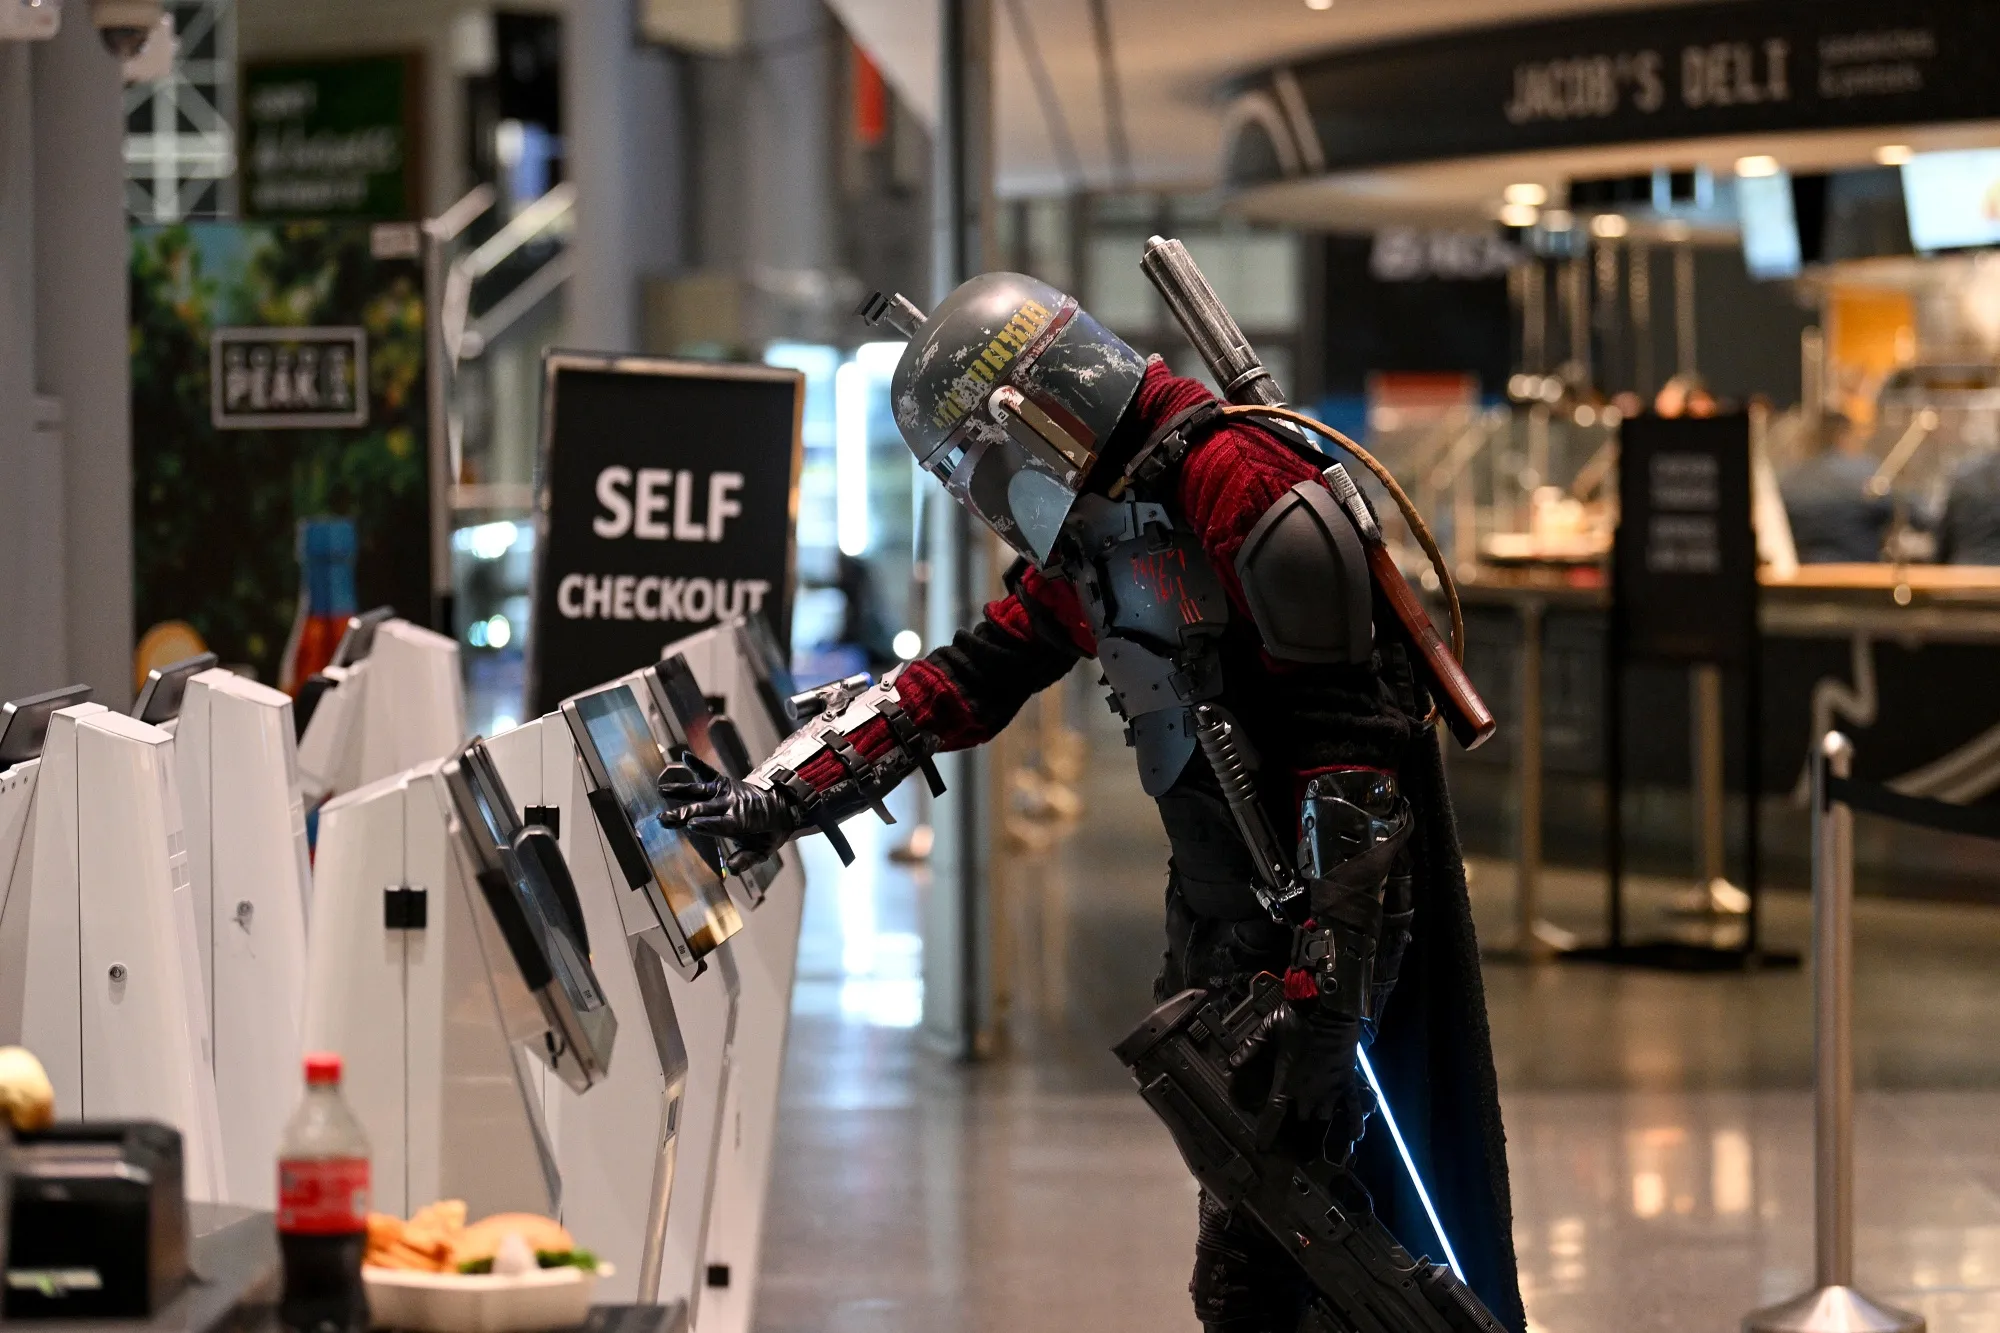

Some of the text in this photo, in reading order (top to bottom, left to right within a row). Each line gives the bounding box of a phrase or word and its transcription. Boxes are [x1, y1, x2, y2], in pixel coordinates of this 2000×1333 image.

[1681, 38, 1788, 107] DELI
[593, 466, 744, 542] SELF
[557, 574, 769, 622] CHECKOUT
